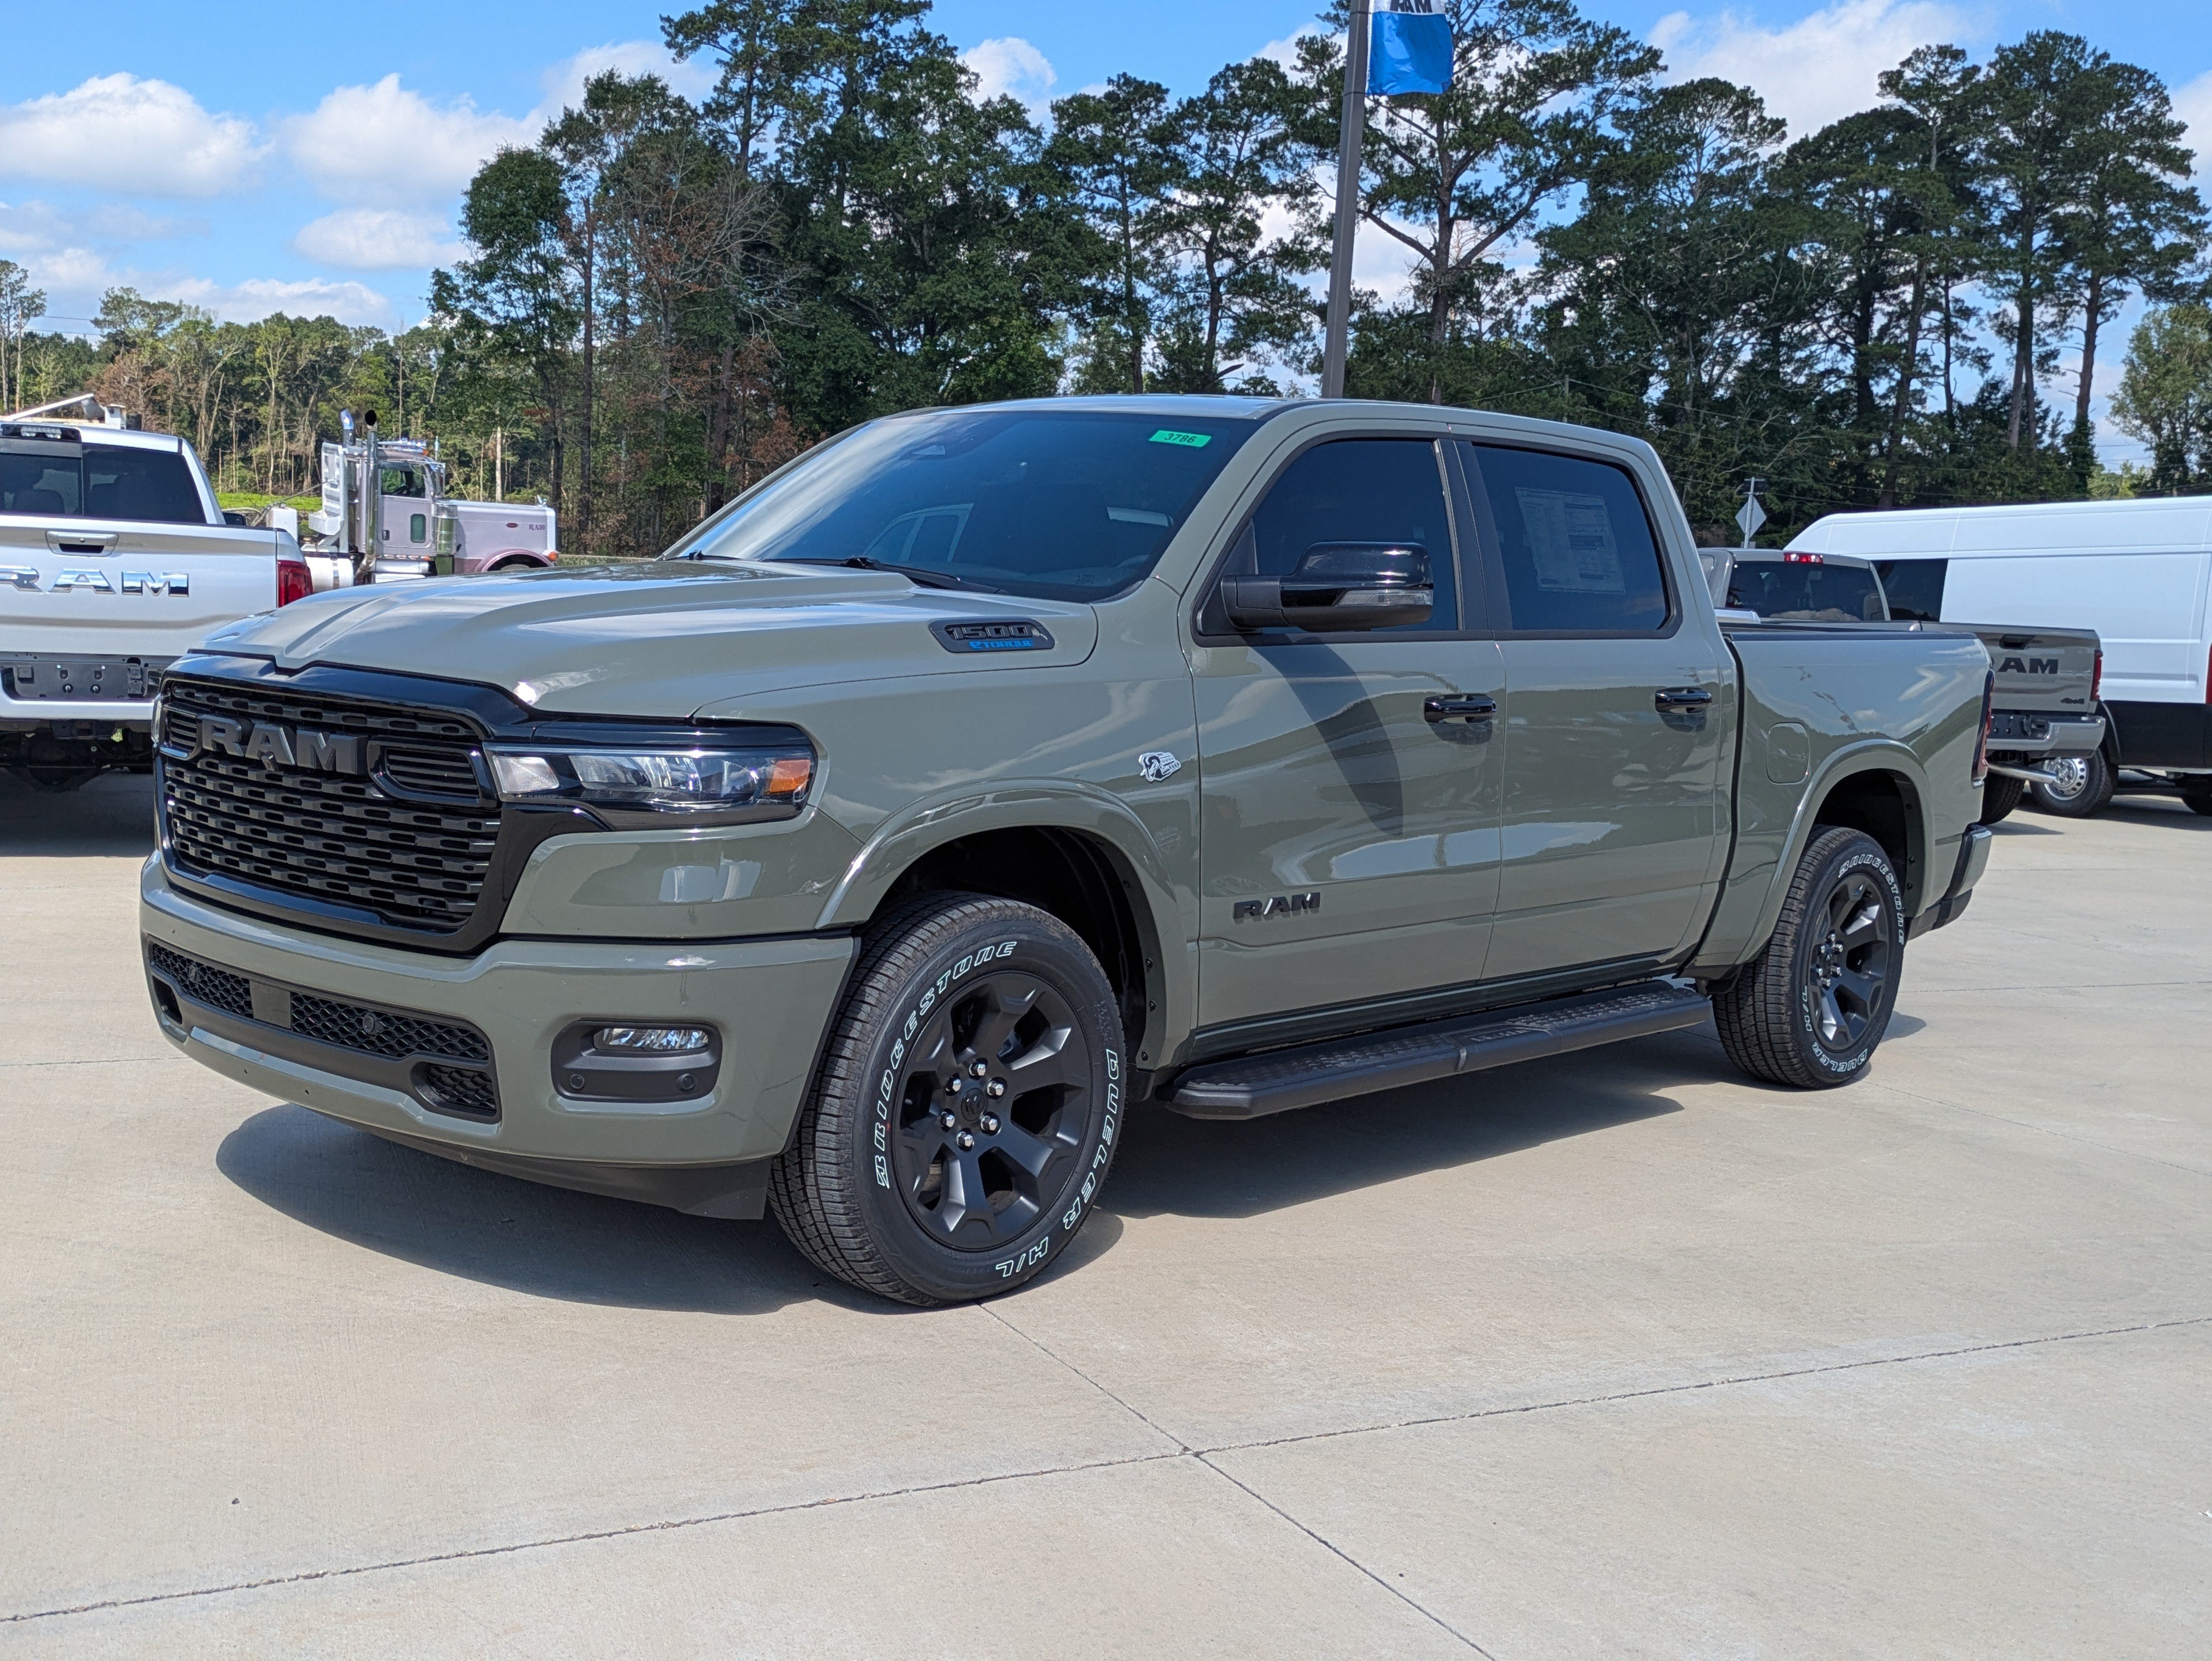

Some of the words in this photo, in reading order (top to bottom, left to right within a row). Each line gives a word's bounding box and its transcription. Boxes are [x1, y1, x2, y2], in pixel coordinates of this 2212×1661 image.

[1164, 433, 1197, 443] 3786
[946, 625, 1033, 640] 1500
[1991, 657, 2058, 674] AM
[201, 714, 367, 775] RAM
[1234, 892, 1321, 919] RAM
[1837, 854, 1905, 945] BRIDGESTONE
[874, 941, 1017, 1189] BRIDGESTONE
[1812, 1041, 1868, 1072] DUELER
[1063, 1049, 1119, 1229] DUELER
[995, 1236, 1049, 1278] H/L
